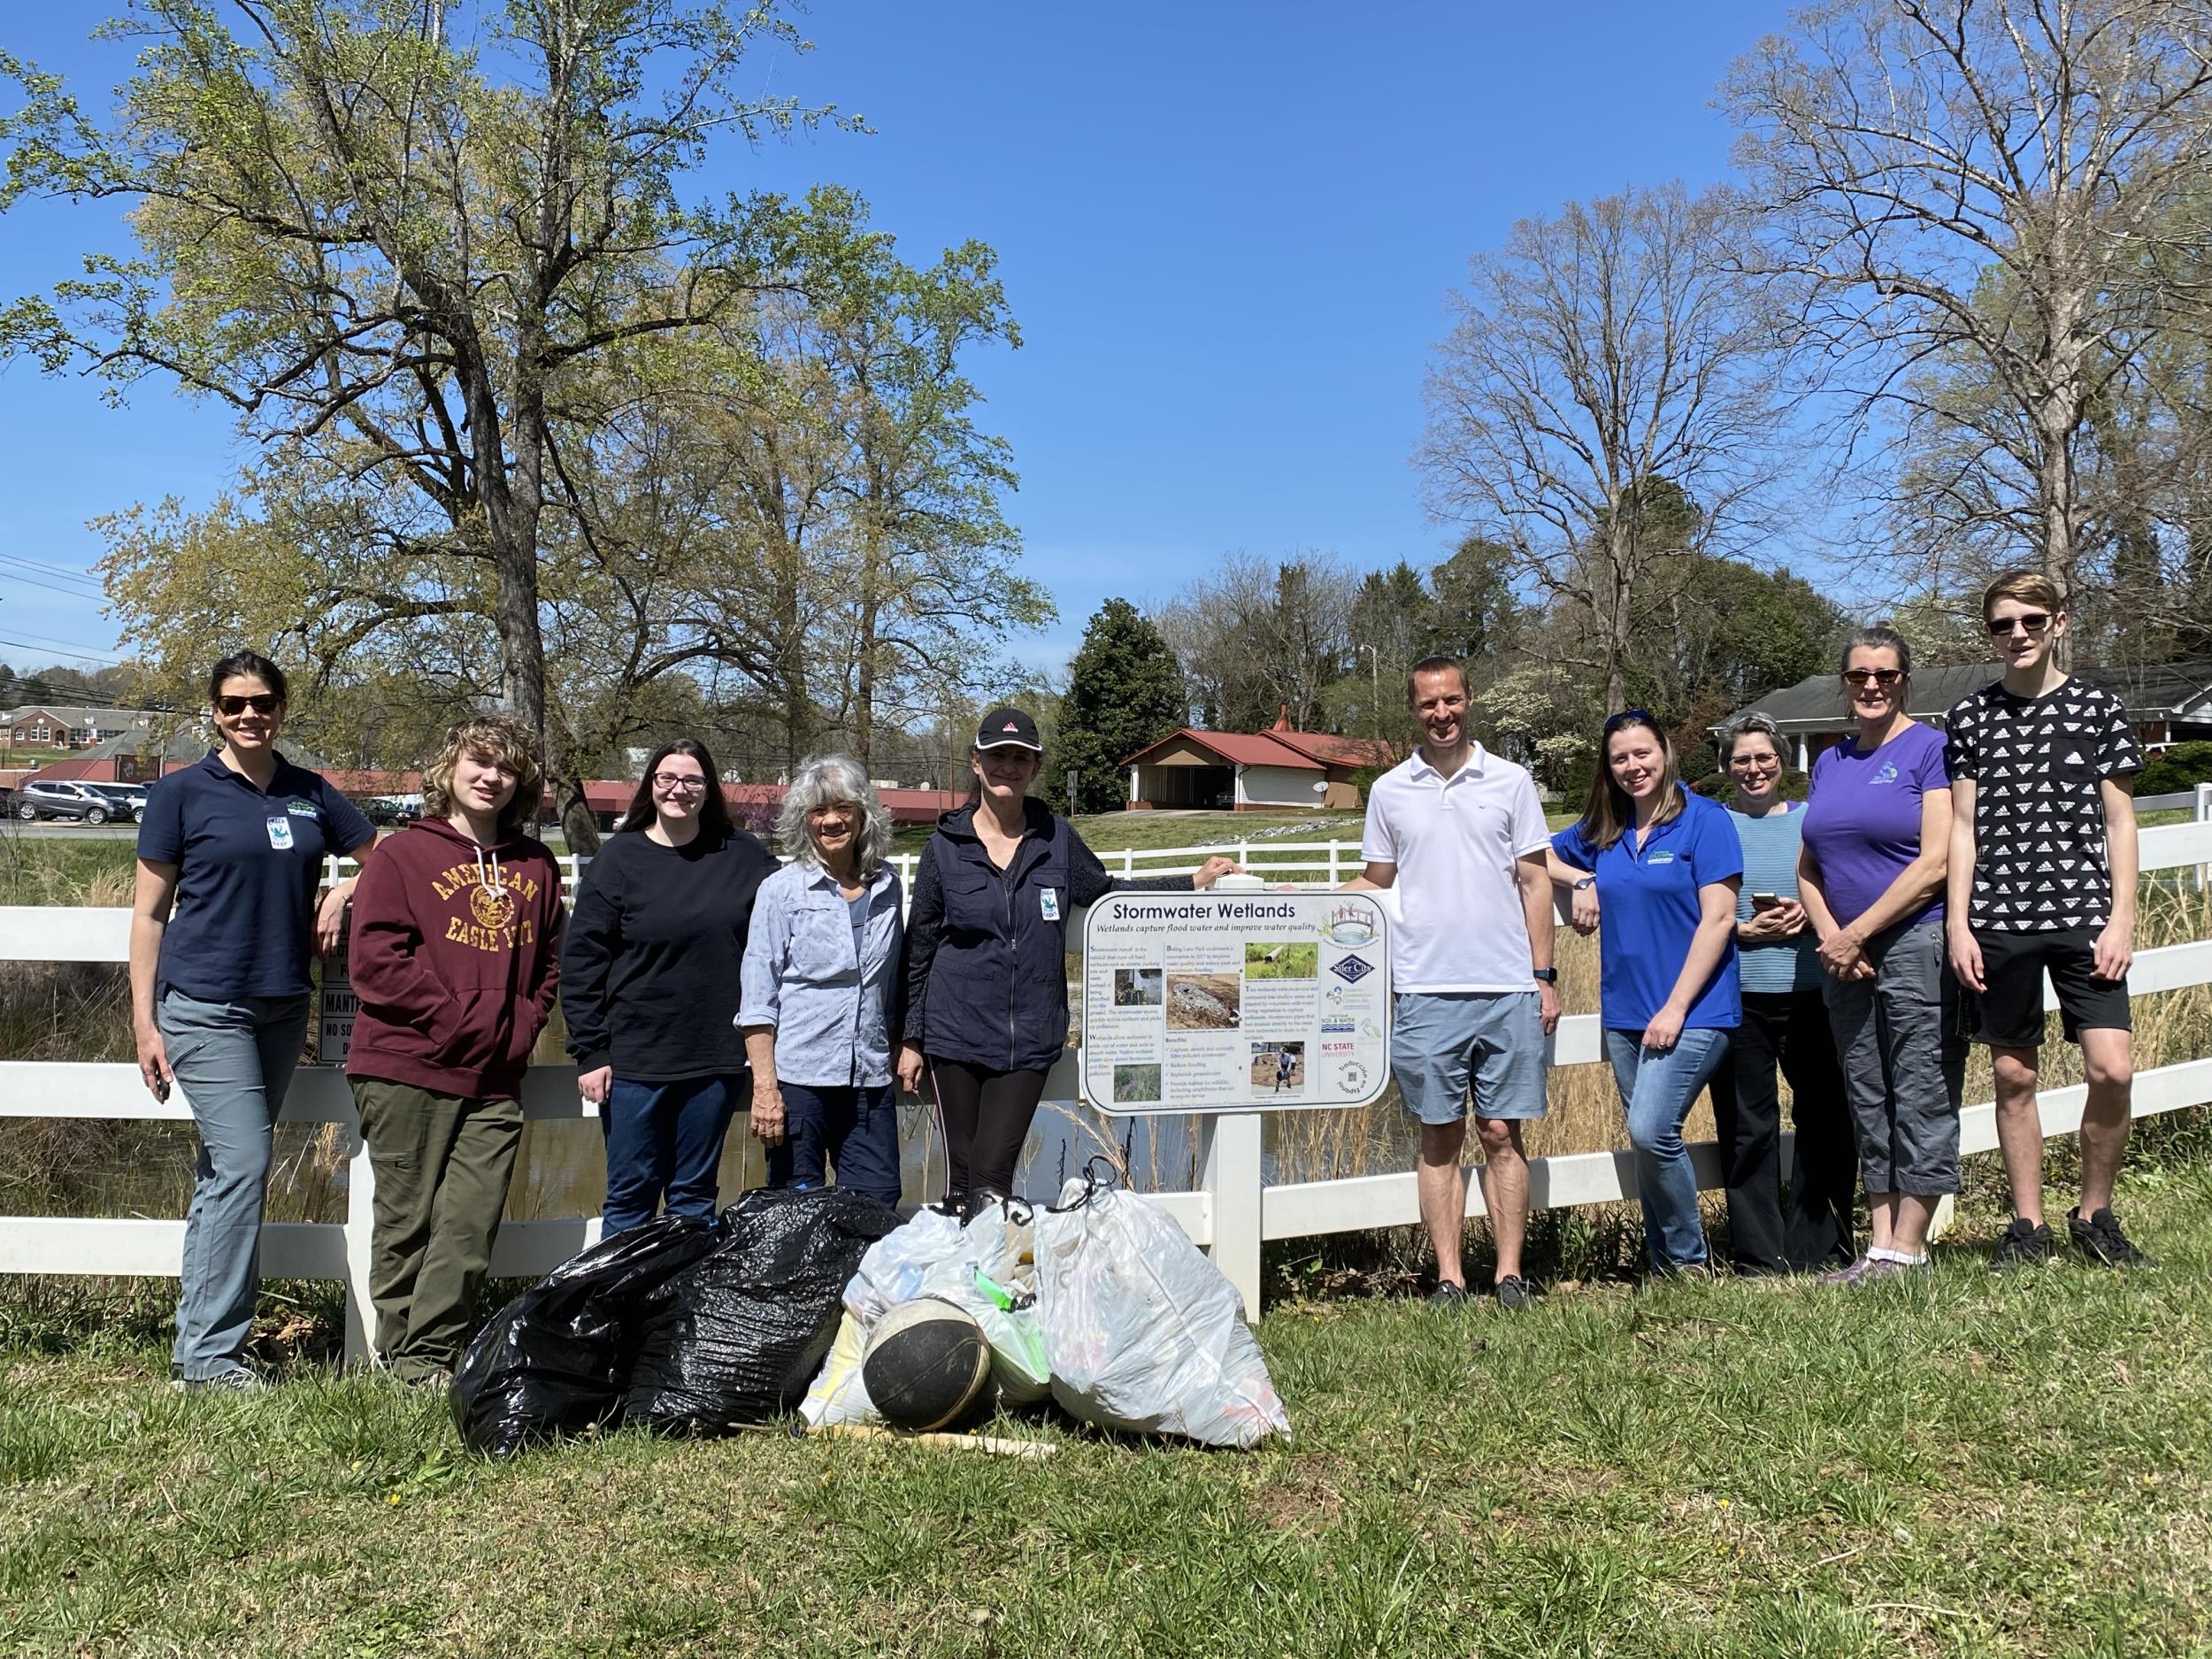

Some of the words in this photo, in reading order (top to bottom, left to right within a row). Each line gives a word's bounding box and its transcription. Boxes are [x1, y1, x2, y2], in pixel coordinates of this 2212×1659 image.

[432, 864, 538, 902] AMERICAN
[1113, 903, 1211, 919] Stormwater
[1217, 902, 1295, 918] Wetlands
[446, 917, 499, 952] EAGLE
[1136, 925, 1165, 934] capture
[1165, 924, 1187, 933] flood
[1231, 925, 1262, 933] improve
[1288, 923, 1316, 933] quality
[1333, 963, 1352, 973] Siler
[1354, 963, 1371, 974] City
[326, 1025, 337, 1035] NO
[341, 1025, 353, 1036] SO
